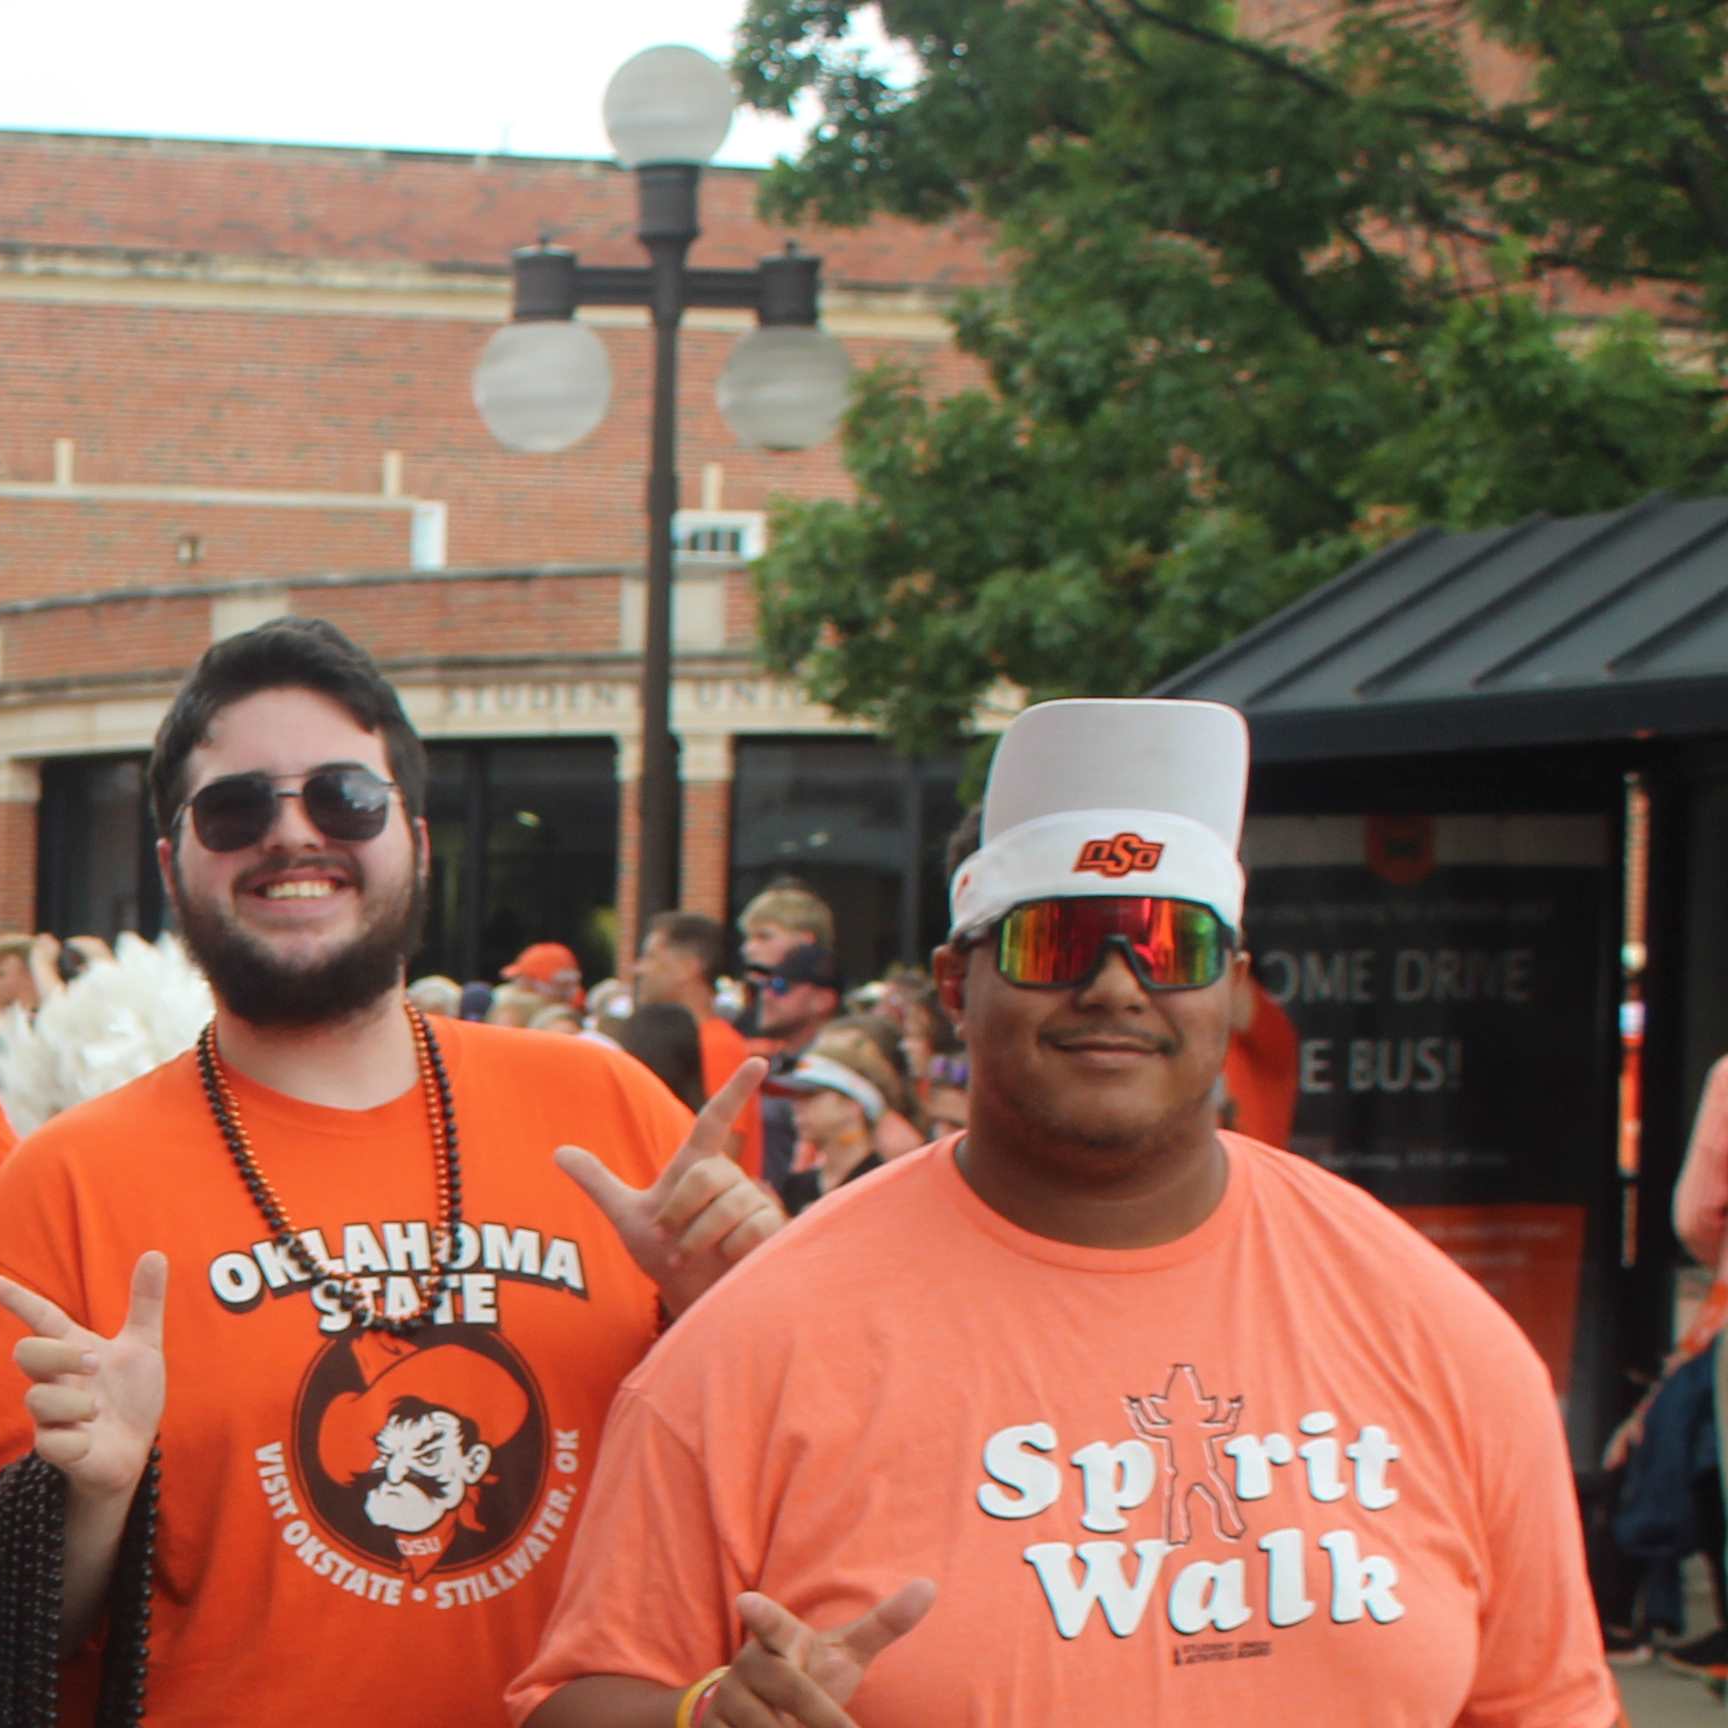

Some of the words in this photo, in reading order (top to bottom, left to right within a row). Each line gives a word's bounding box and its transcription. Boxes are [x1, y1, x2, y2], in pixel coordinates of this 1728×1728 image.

[1394, 948, 1534, 1004] DRIVE
[1348, 1037, 1463, 1093] BUS!
[208, 1221, 588, 1307] OKLAHOMA
[310, 1272, 497, 1334] STATE
[255, 1441, 301, 1520] VISIT
[282, 1519, 405, 1606] OKSTATE
[435, 1484, 578, 1609] STILLWATER,
[554, 1429, 580, 1473] OK
[1023, 1527, 1406, 1639] Walk
